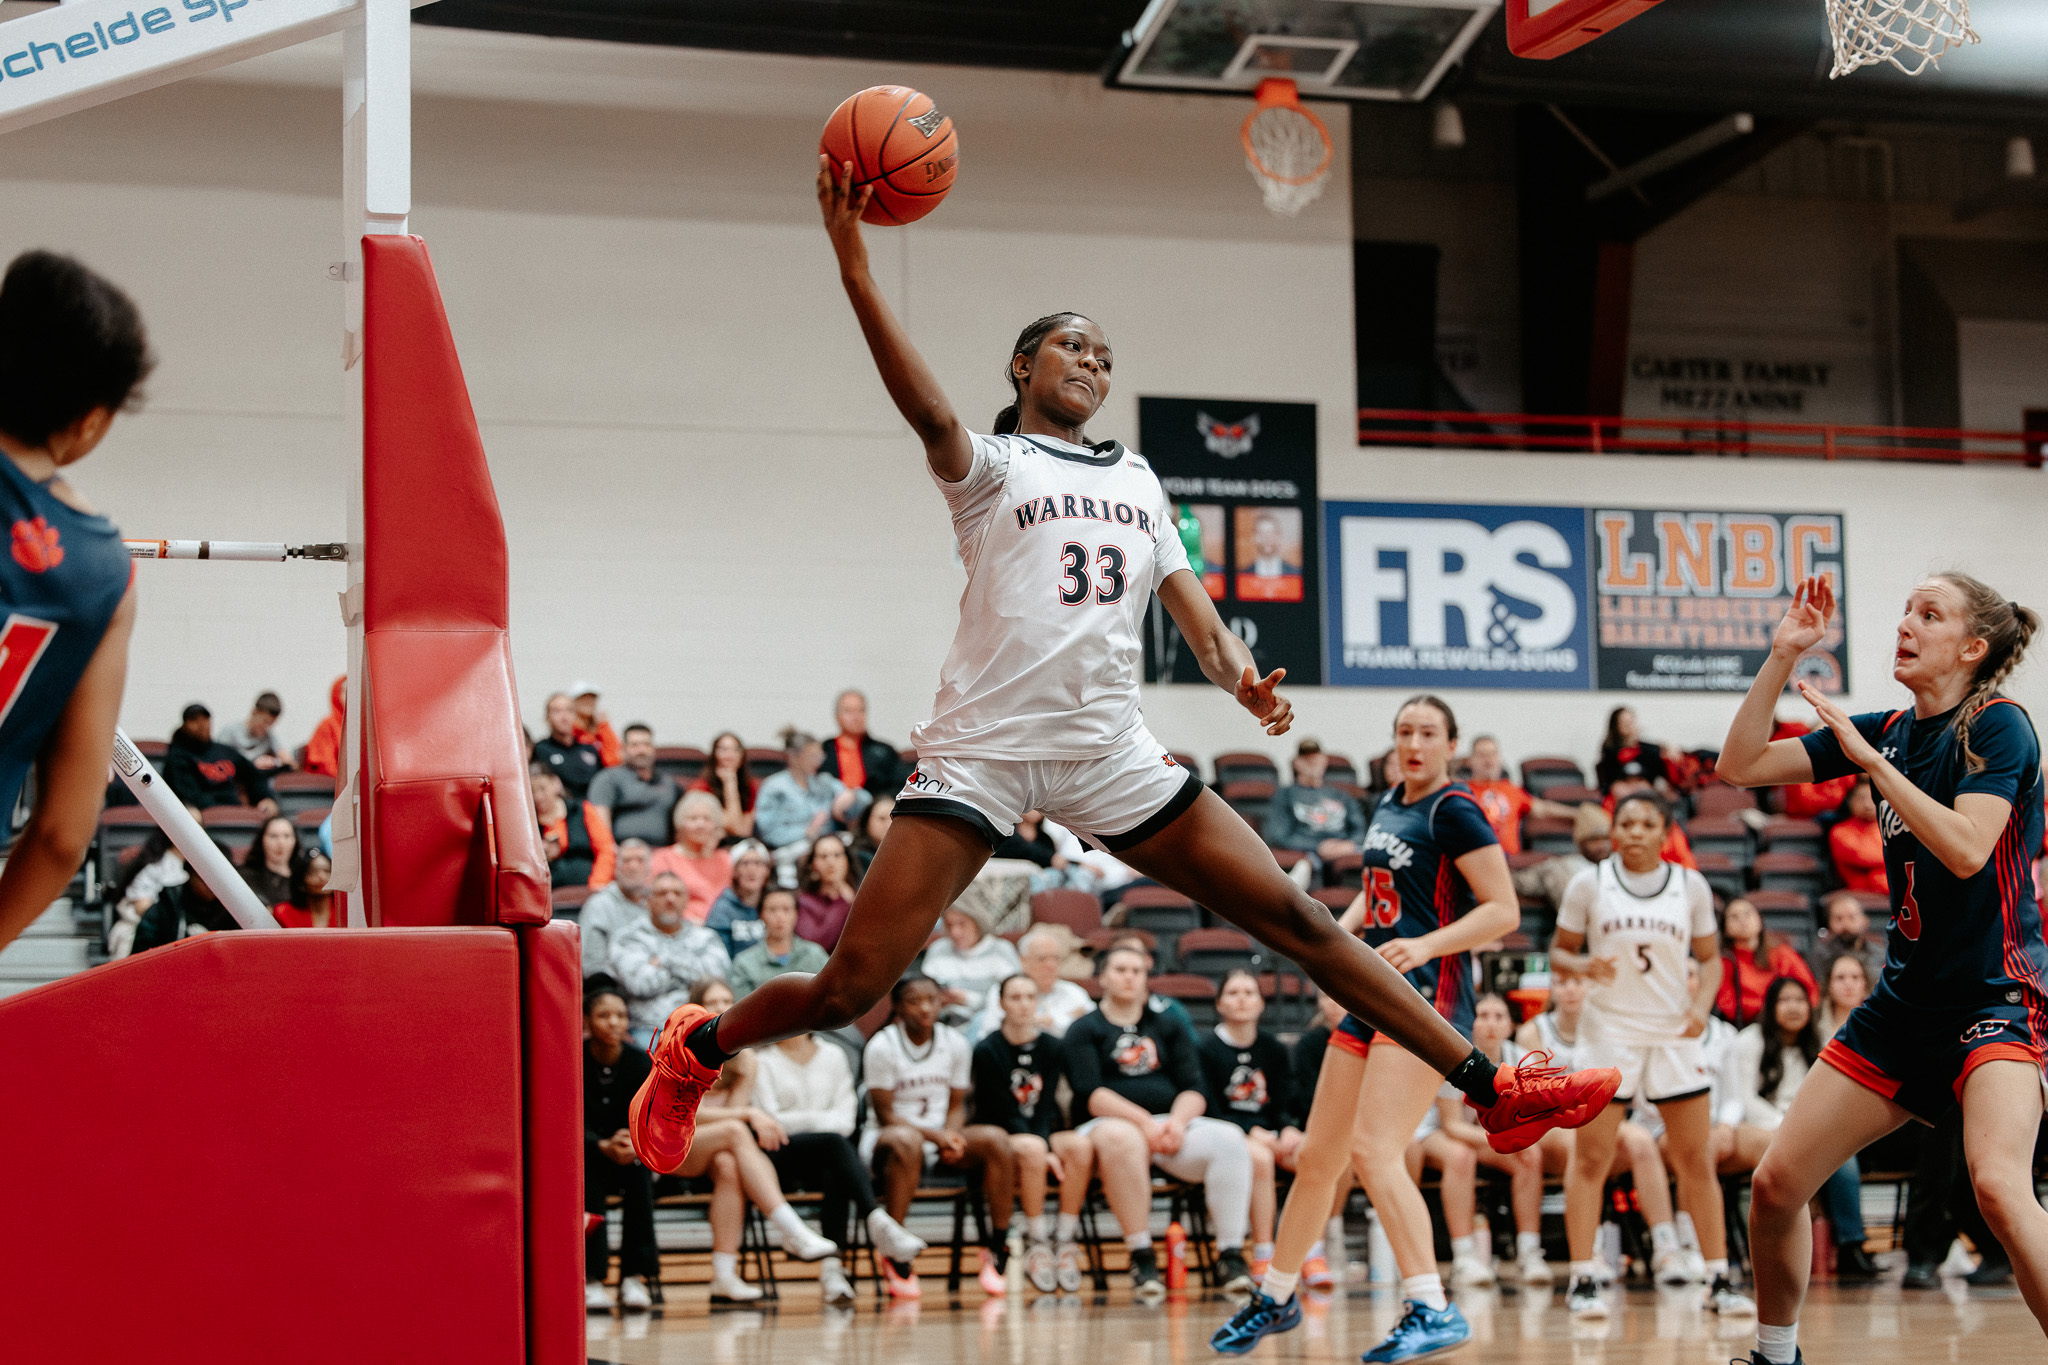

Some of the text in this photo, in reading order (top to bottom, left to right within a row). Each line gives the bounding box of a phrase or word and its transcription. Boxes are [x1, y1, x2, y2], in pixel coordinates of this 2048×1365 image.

[0, 8, 176, 83] chelde
[1631, 355, 1733, 382] CARTER
[1206, 477, 1249, 497] TEAM
[1058, 541, 1128, 607] 33
[1595, 510, 1843, 598] LNBC
[1344, 646, 1415, 669] FRANK
[1362, 866, 1402, 928] 15
[1637, 943, 1653, 974] 5
